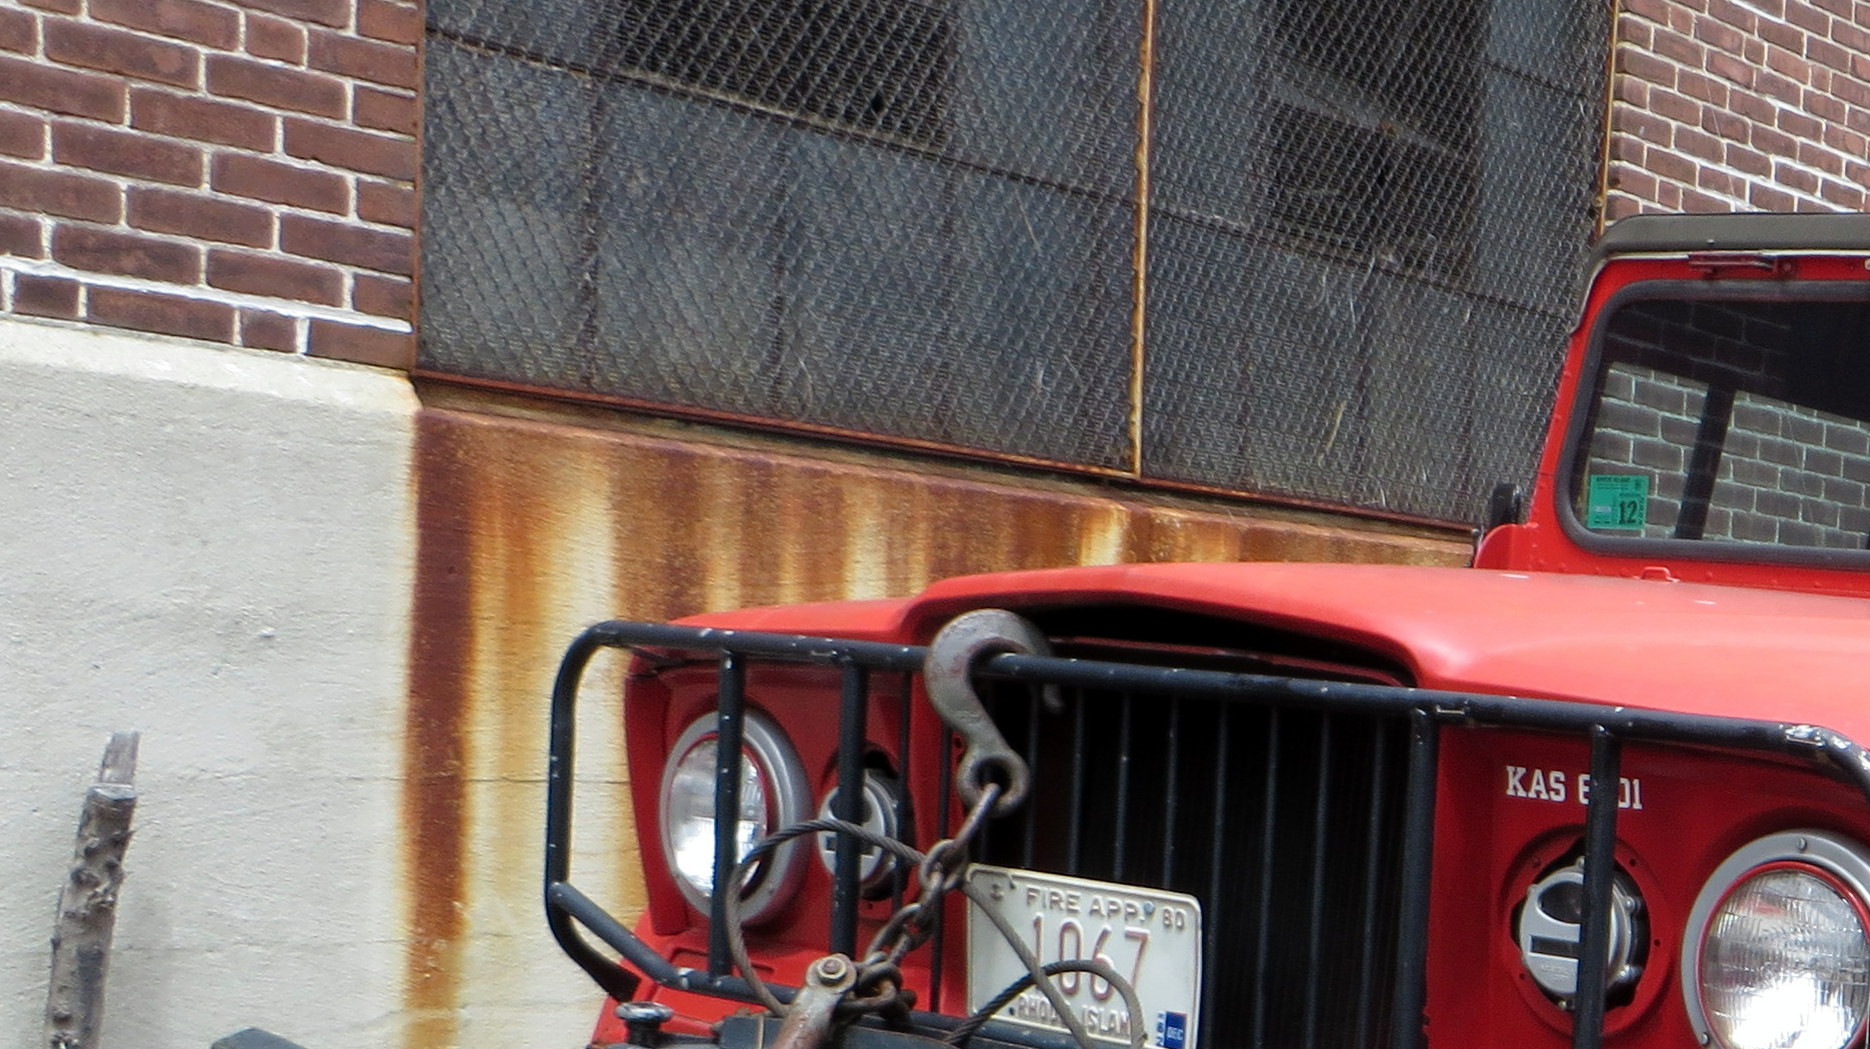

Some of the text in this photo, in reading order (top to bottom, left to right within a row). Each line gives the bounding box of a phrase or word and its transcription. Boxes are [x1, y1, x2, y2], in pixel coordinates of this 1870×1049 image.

[1619, 500, 1638, 524] 12
[1506, 765, 1643, 810] KAS 601
[1026, 885, 1081, 914] FIRE
[1032, 912, 1151, 1002] 1067
